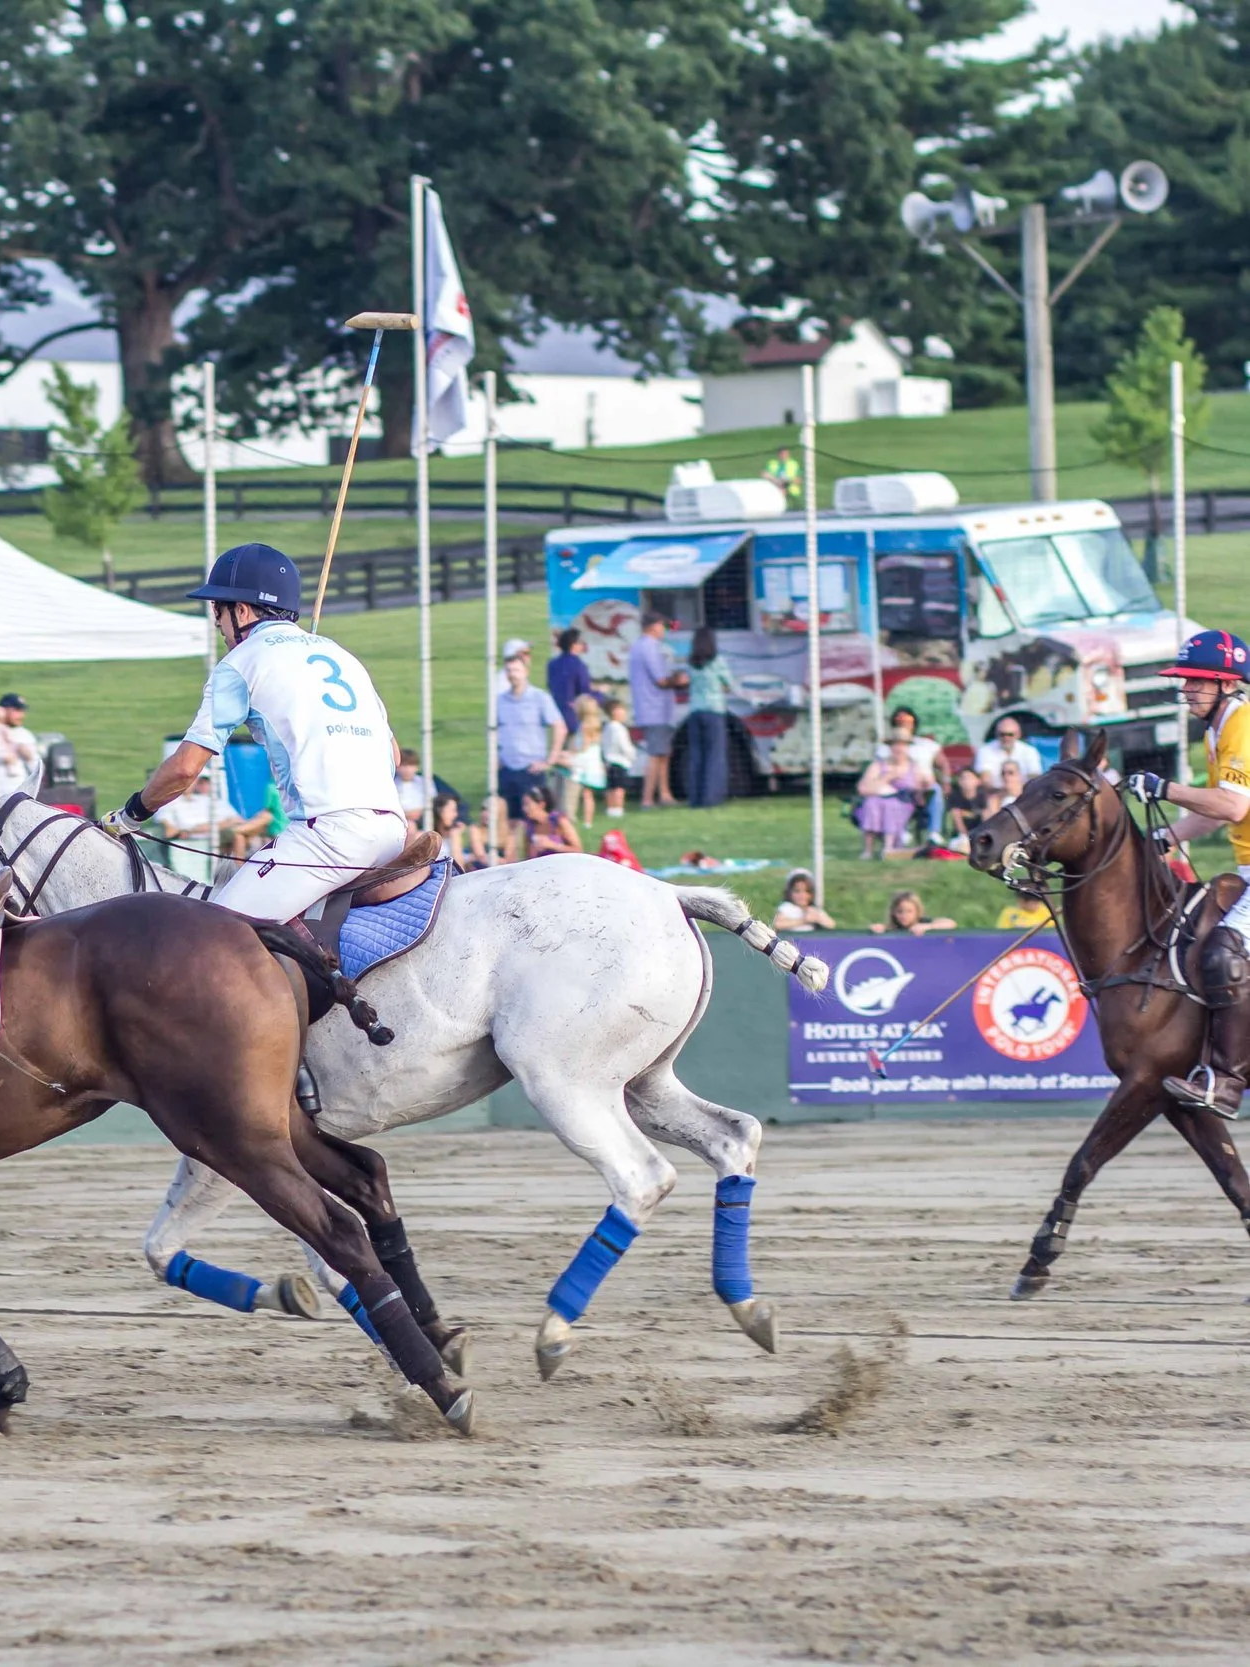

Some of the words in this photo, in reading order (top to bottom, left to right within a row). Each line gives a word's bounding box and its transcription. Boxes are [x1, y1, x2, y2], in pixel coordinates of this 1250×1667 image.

[306, 654, 357, 712] 3
[976, 951, 1083, 1005] INTERNATIONAL
[803, 1022, 878, 1040] HOTELS
[880, 1022, 905, 1039] AT
[985, 1020, 1031, 1059] POLO
[1032, 1020, 1076, 1058] TOUR
[830, 1076, 870, 1092] Book
[871, 1079, 909, 1095] your
[909, 1075, 949, 1091] Suite
[952, 1074, 987, 1090] with
[988, 1073, 1037, 1089] Hotels
[1039, 1074, 1058, 1089] at
